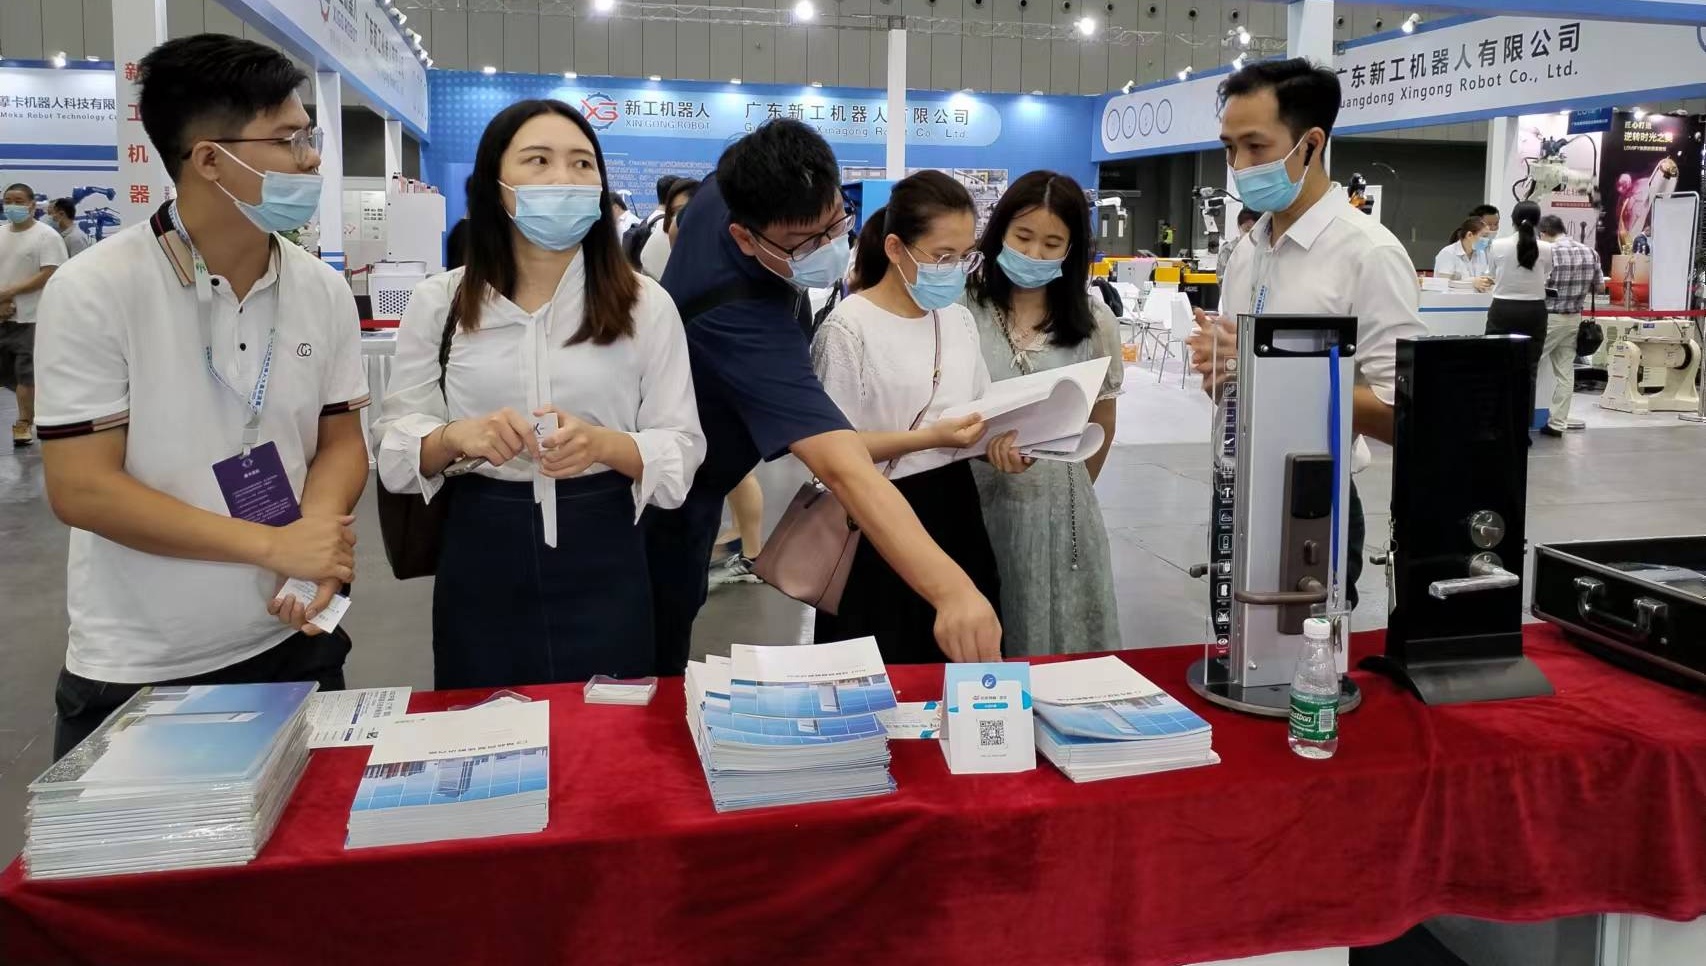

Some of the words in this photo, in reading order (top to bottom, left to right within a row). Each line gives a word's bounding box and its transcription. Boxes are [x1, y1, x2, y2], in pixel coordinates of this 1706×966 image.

[1340, 92, 1394, 110] uangdong
[1400, 82, 1453, 101] Xingong
[1459, 73, 1502, 91] Robot
[1509, 69, 1538, 84] Co.,
[1547, 60, 1578, 79] Ltd.
[57, 113, 105, 121] Technology
[625, 99, 710, 118] 新工机器人
[745, 101, 969, 126] 广东新工机器人限公司
